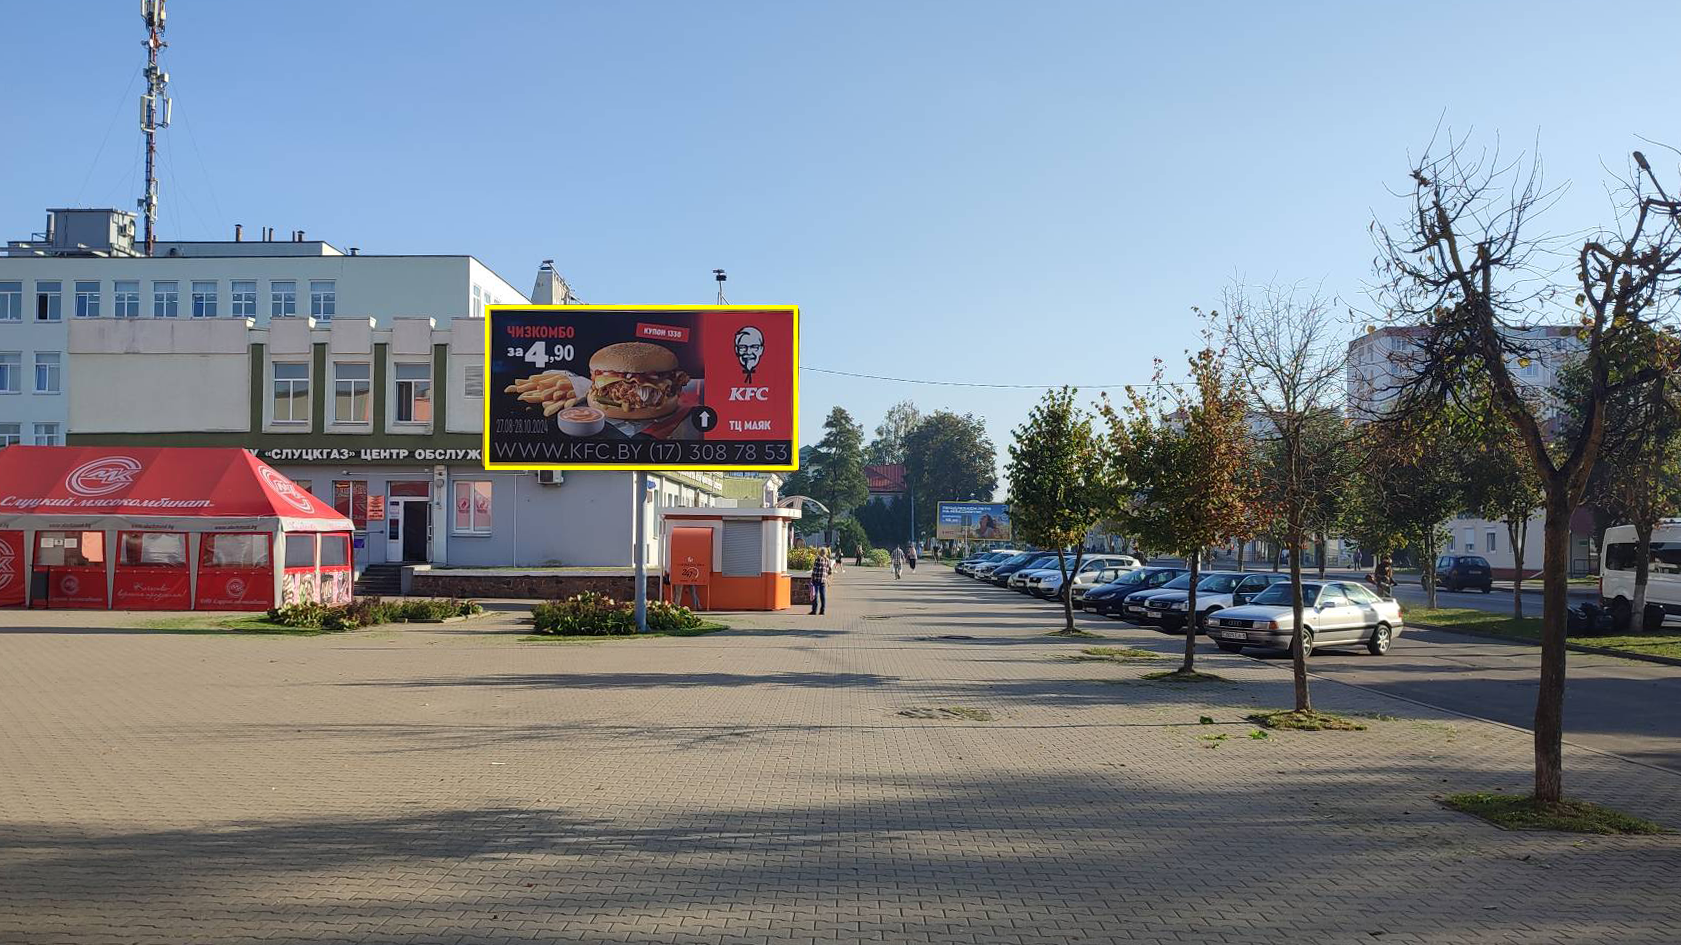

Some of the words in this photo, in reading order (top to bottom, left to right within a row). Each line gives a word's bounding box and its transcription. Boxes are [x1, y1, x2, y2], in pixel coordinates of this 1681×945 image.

[506, 325, 575, 338] ЧИЗКОМБО
[643, 327, 666, 337] КУПОН
[507, 347, 524, 357] за
[525, 341, 575, 368] 4,90
[728, 387, 769, 401] KFC
[729, 420, 742, 432] ТЦ
[744, 420, 771, 430] МАЯК
[264, 448, 356, 461] «СЛУЦКГАЗ»
[361, 448, 409, 461] ЦЕНТР
[494, 442, 642, 460] WWW.KFC.BY
[649, 442, 682, 462] (17)
[689, 444, 727, 460] 308
[734, 444, 757, 460] 78
[764, 444, 788, 460] 53
[0, 495, 76, 509] Слуцкий
